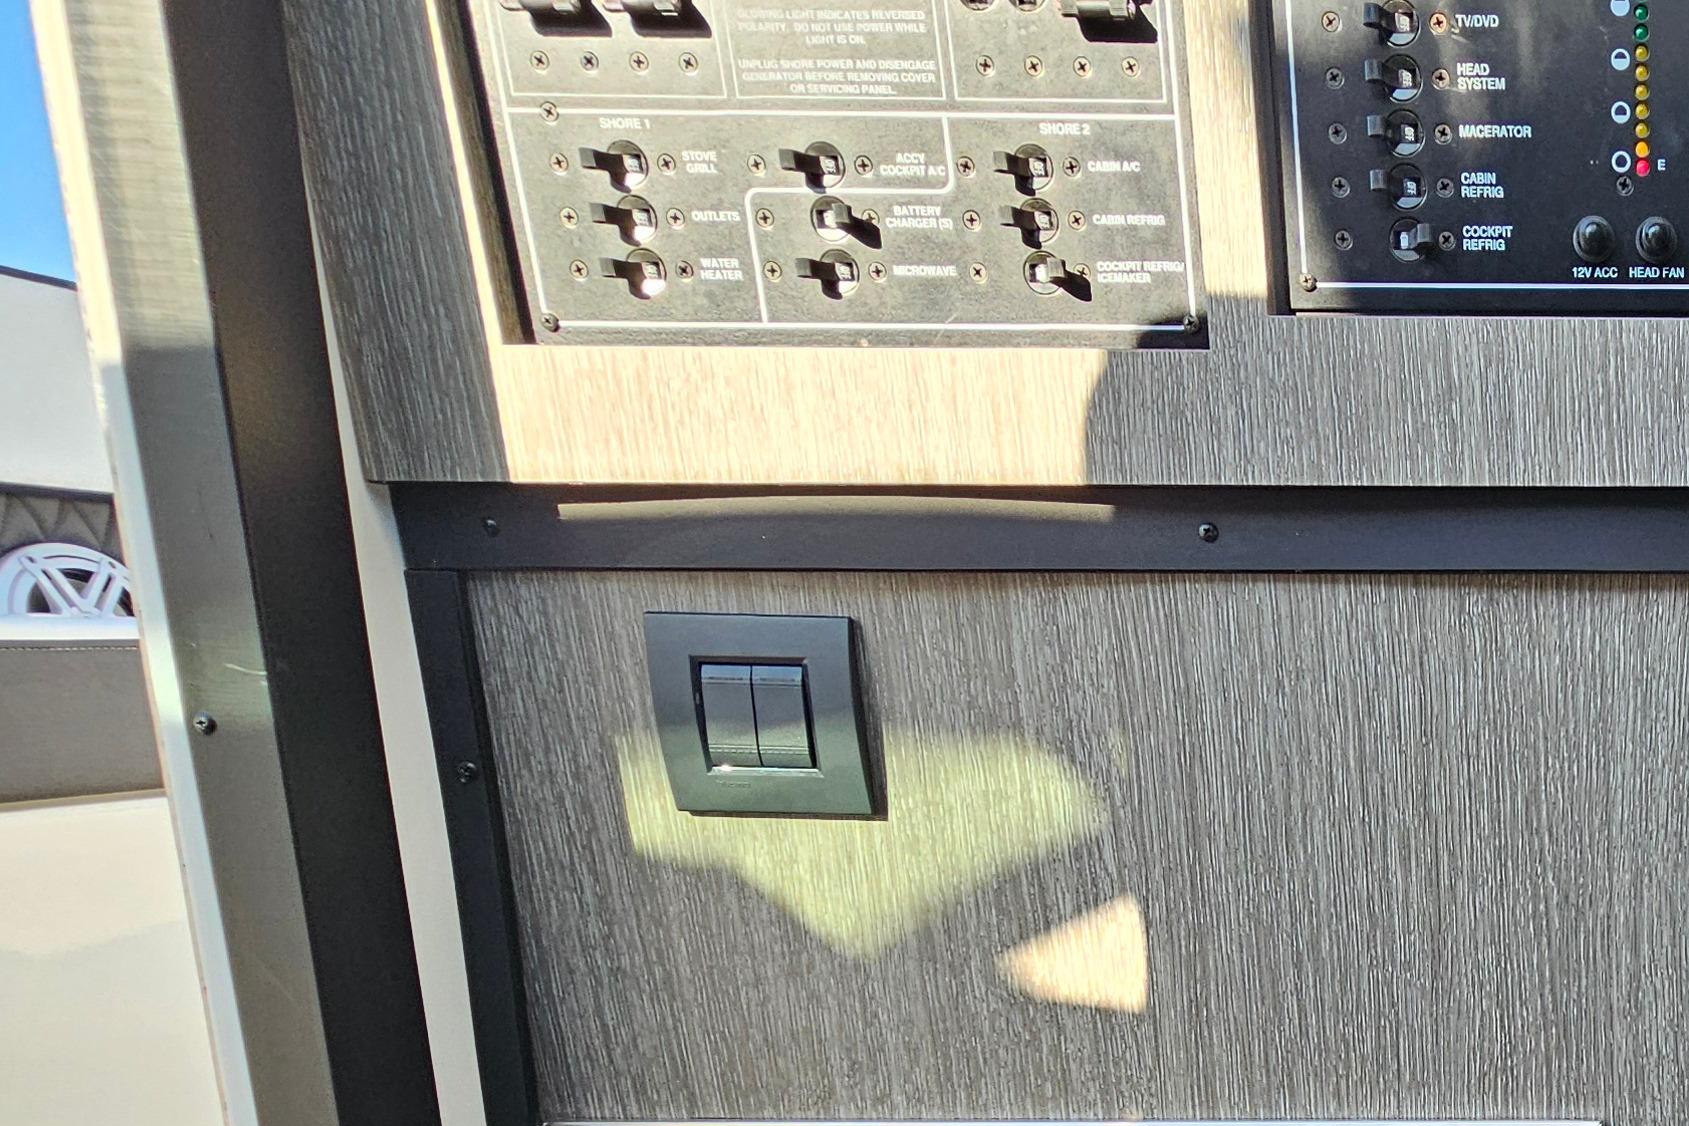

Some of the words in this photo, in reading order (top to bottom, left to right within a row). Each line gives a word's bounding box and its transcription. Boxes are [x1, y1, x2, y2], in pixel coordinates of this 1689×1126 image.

[1455, 14, 1499, 28] TV/DVD
[1457, 63, 1489, 75] HEAD
[1457, 77, 1505, 90] SYSTEM
[599, 118, 642, 129] SHORE
[644, 119, 651, 129] 1
[1039, 123, 1081, 135] SHORE
[1082, 124, 1091, 135] 2
[1458, 125, 1532, 138] MACERATOR
[682, 151, 718, 161] STOVE
[686, 163, 718, 173] GRILL
[880, 164, 926, 176] COCKPIT
[1087, 161, 1121, 172] CABIN
[1122, 161, 1141, 172] A/C
[1657, 159, 1666, 171] E
[1461, 173, 1496, 184] CABIN
[1461, 186, 1504, 198] REFRIG
[691, 210, 741, 222] OUTLETS
[893, 205, 941, 216] BATTERY
[885, 217, 937, 229] CHARGER
[1092, 214, 1126, 225] CABIN
[1127, 214, 1166, 225] REFRIG
[1462, 225, 1513, 238] COCKPIT
[1462, 239, 1506, 251] REFRIG
[701, 258, 739, 269] WATER
[1097, 261, 1142, 272] COCKPIT
[701, 270, 744, 281] HEATER
[893, 265, 957, 276] MICROWAVE
[1572, 267, 1593, 278] 12V
[1594, 267, 1618, 278] ACC
[1629, 267, 1660, 278] HEAD
[1662, 267, 1685, 279] FAN
[1097, 273, 1151, 284] ICEMAKER
